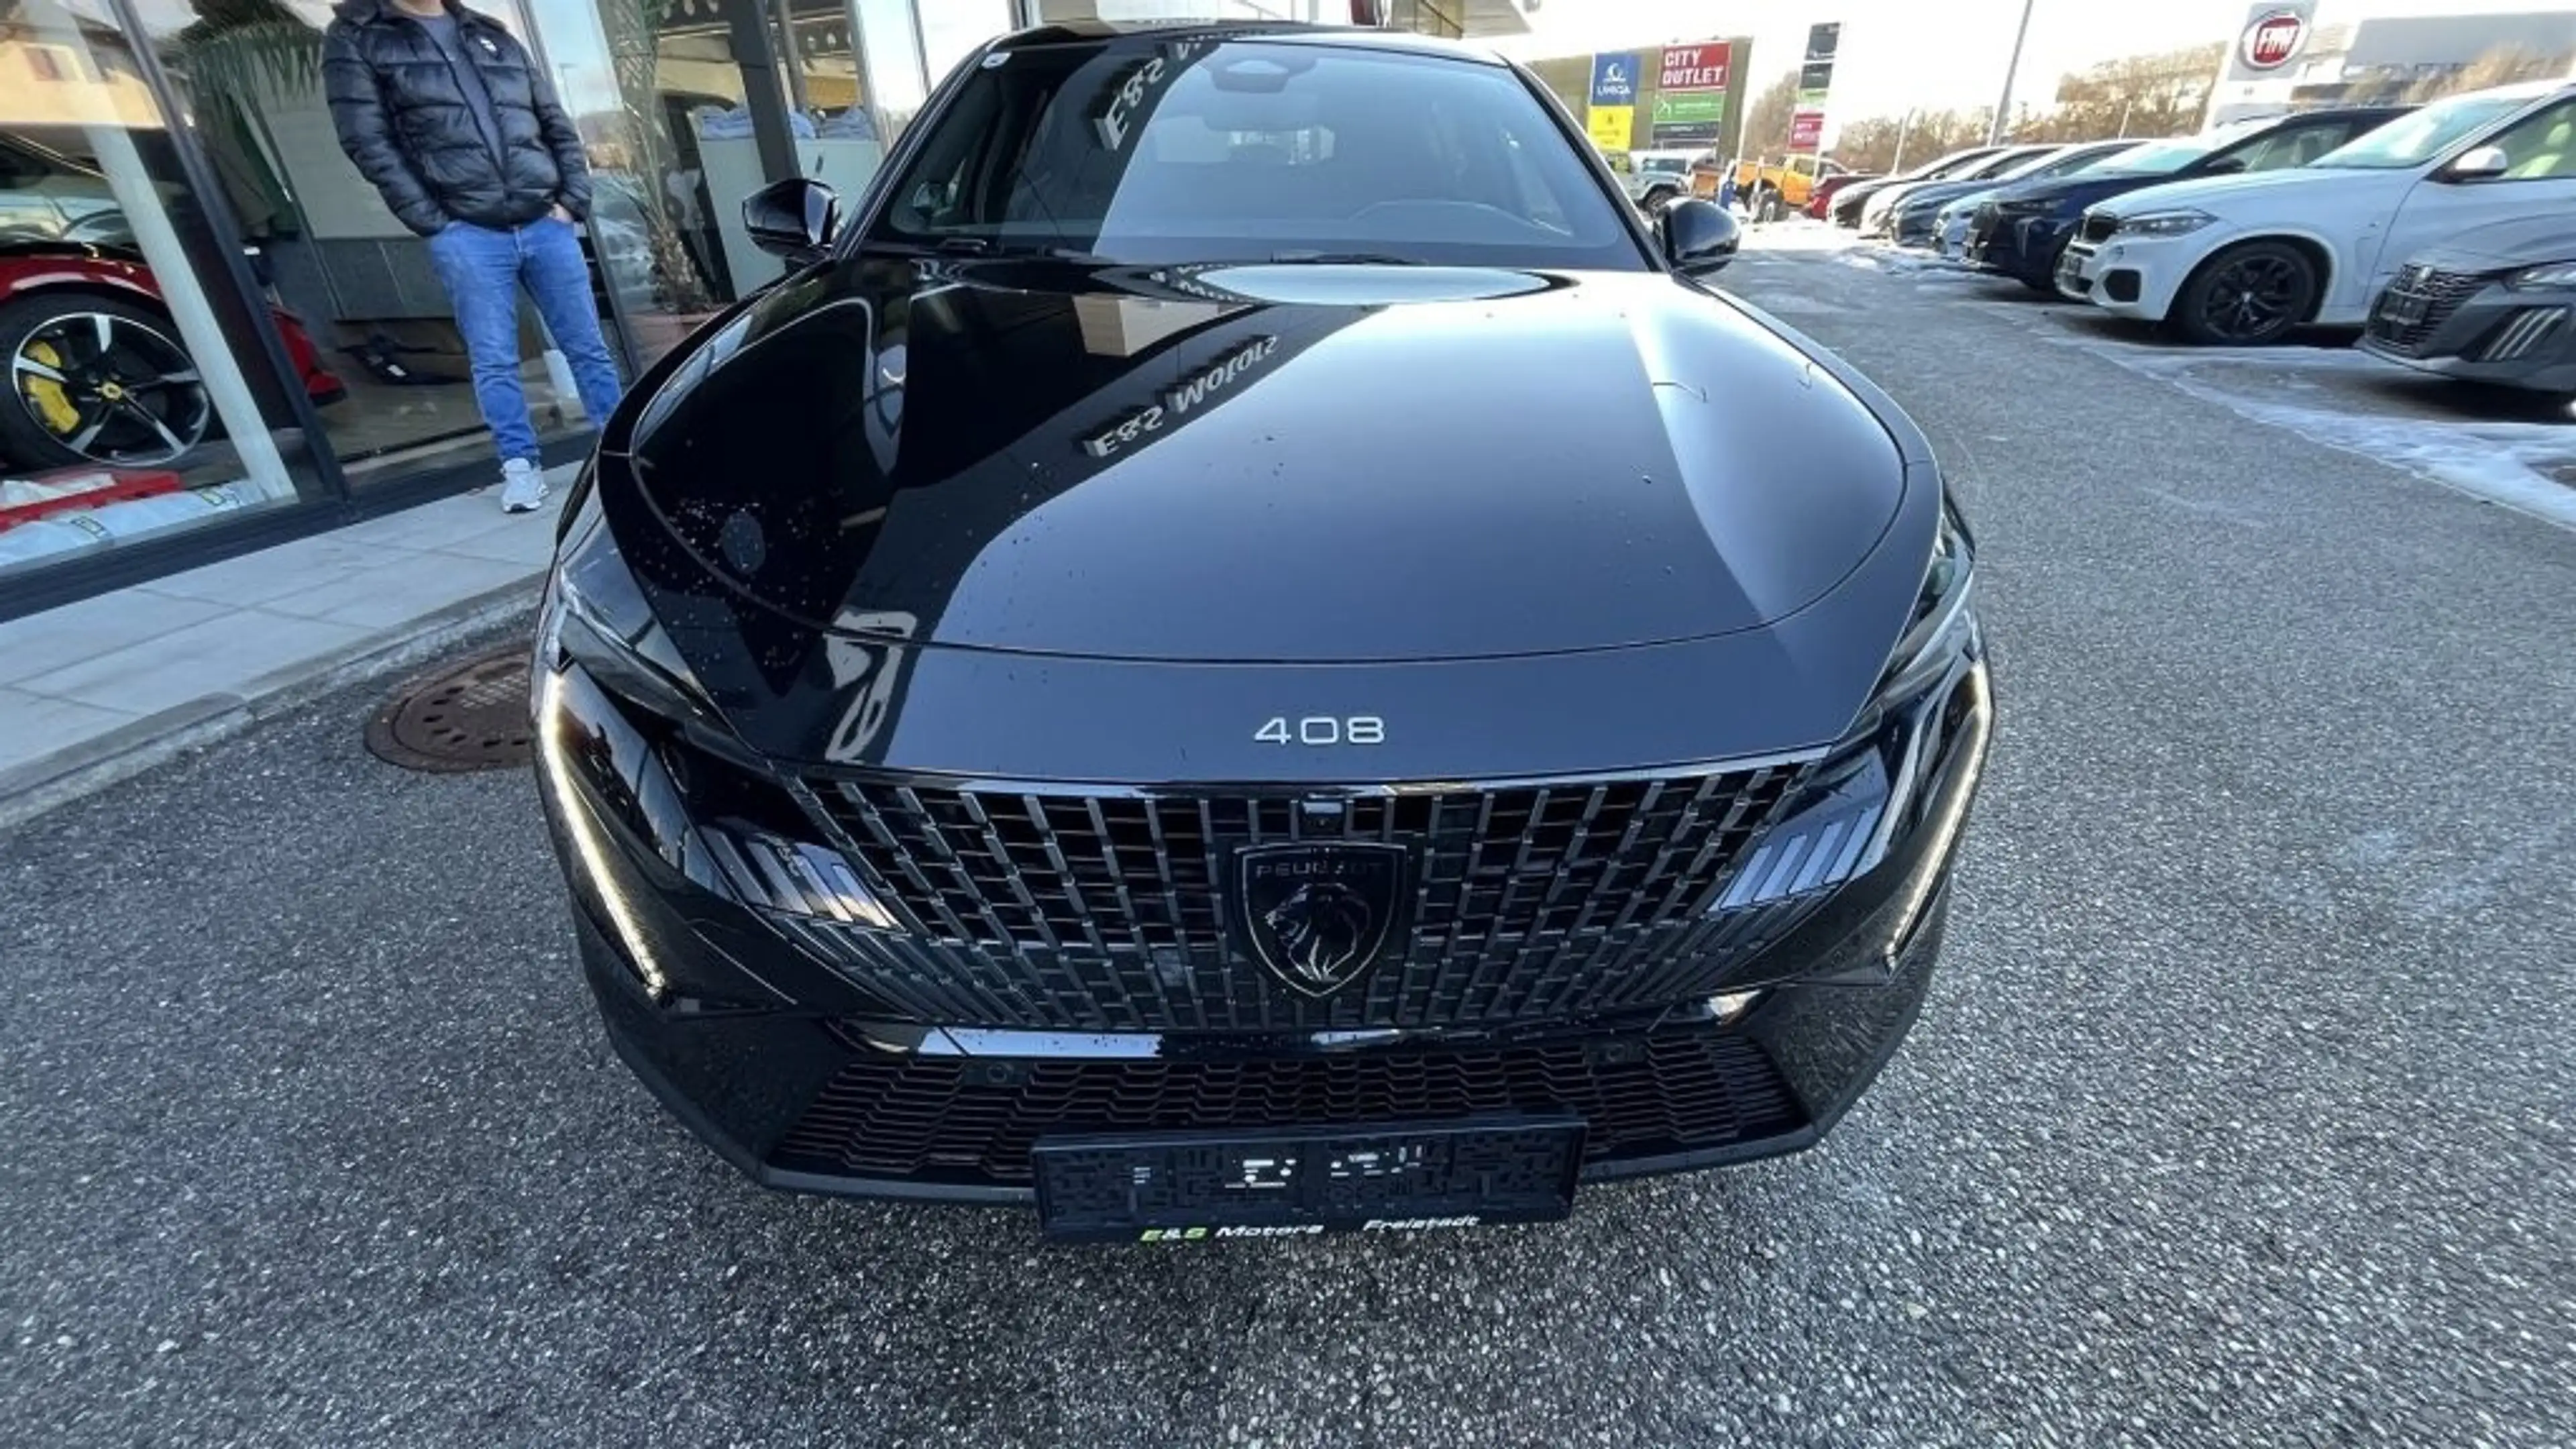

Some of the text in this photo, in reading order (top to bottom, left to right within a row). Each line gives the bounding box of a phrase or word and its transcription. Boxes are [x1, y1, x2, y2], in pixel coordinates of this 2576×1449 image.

[1665, 49, 1701, 66] CITY
[1662, 66, 1723, 85] OUTLET
[1254, 716, 1385, 744] 408
[1215, 1225, 1324, 1238] Motors
